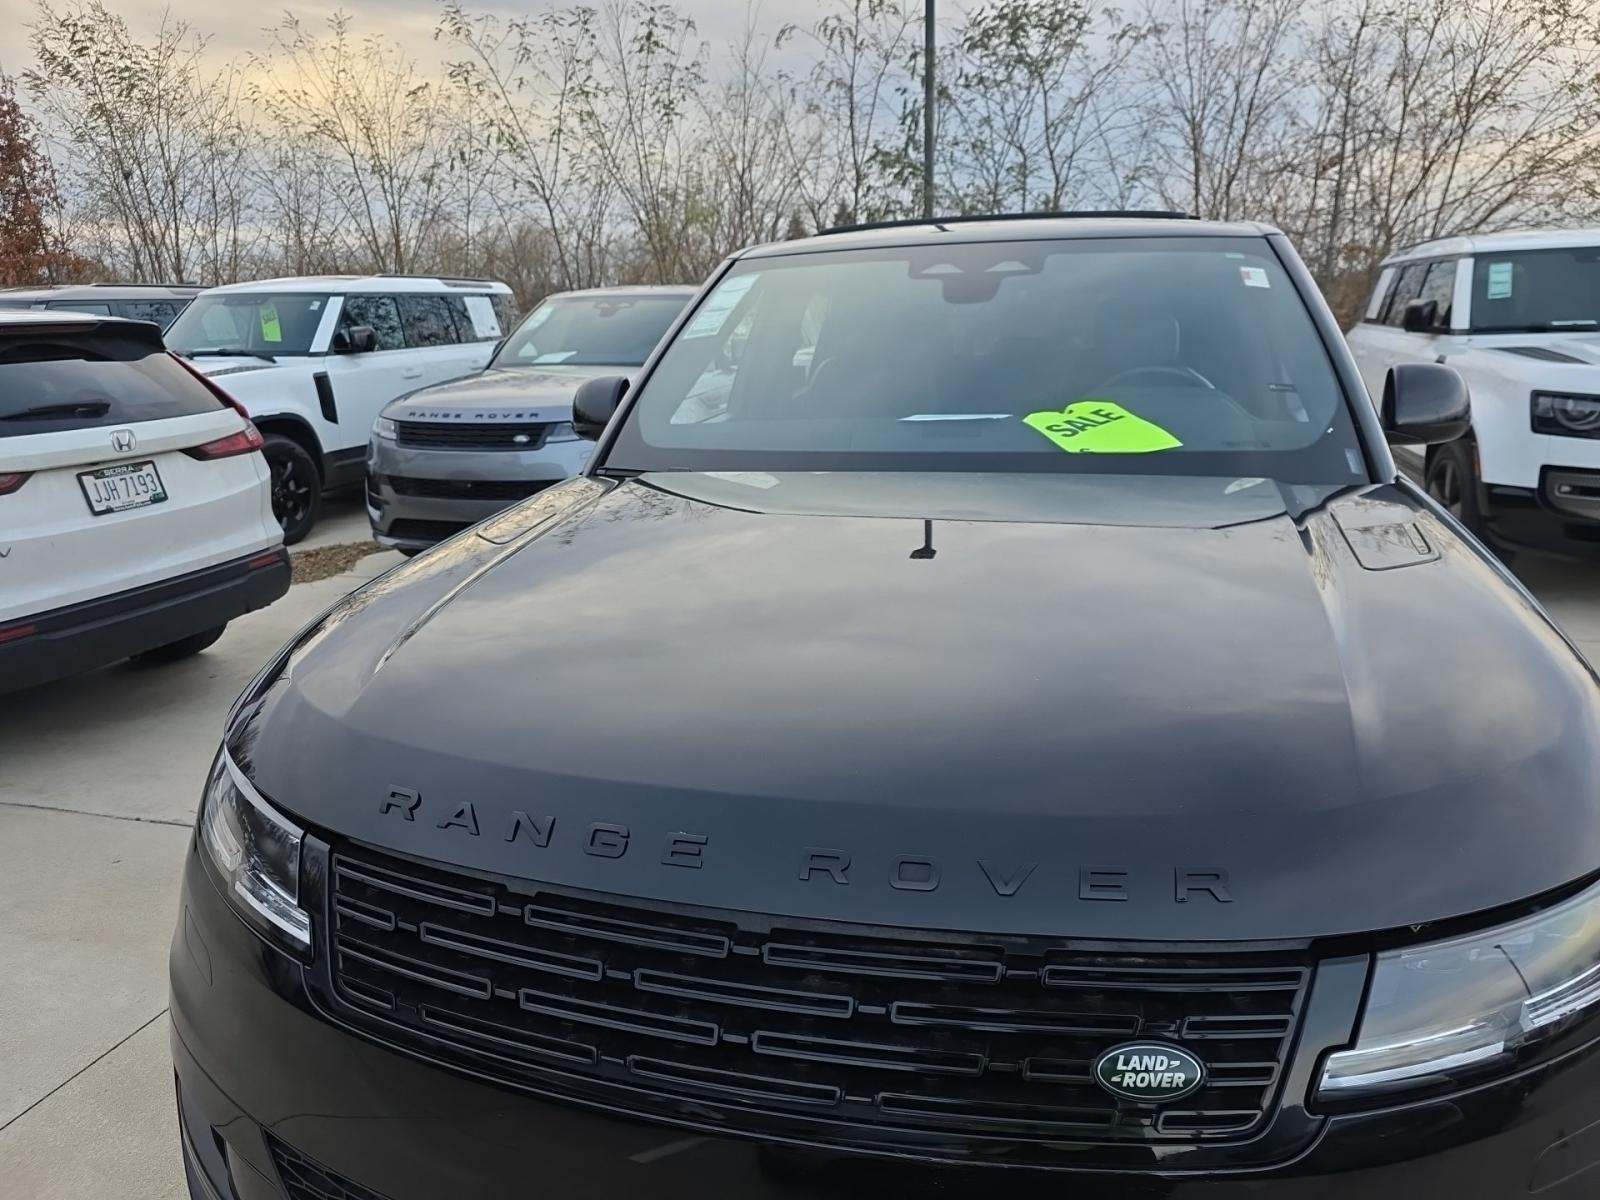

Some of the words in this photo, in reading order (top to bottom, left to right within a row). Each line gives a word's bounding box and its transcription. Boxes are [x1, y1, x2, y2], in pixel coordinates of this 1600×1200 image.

[1045, 408, 1126, 437] SALE
[93, 480, 121, 504] JJH
[120, 473, 158, 498] 7193
[378, 784, 710, 870] RANGE
[799, 846, 1235, 904] ROVER
[1116, 1054, 1170, 1071] LAND
[1122, 1071, 1186, 1088] ROVER
